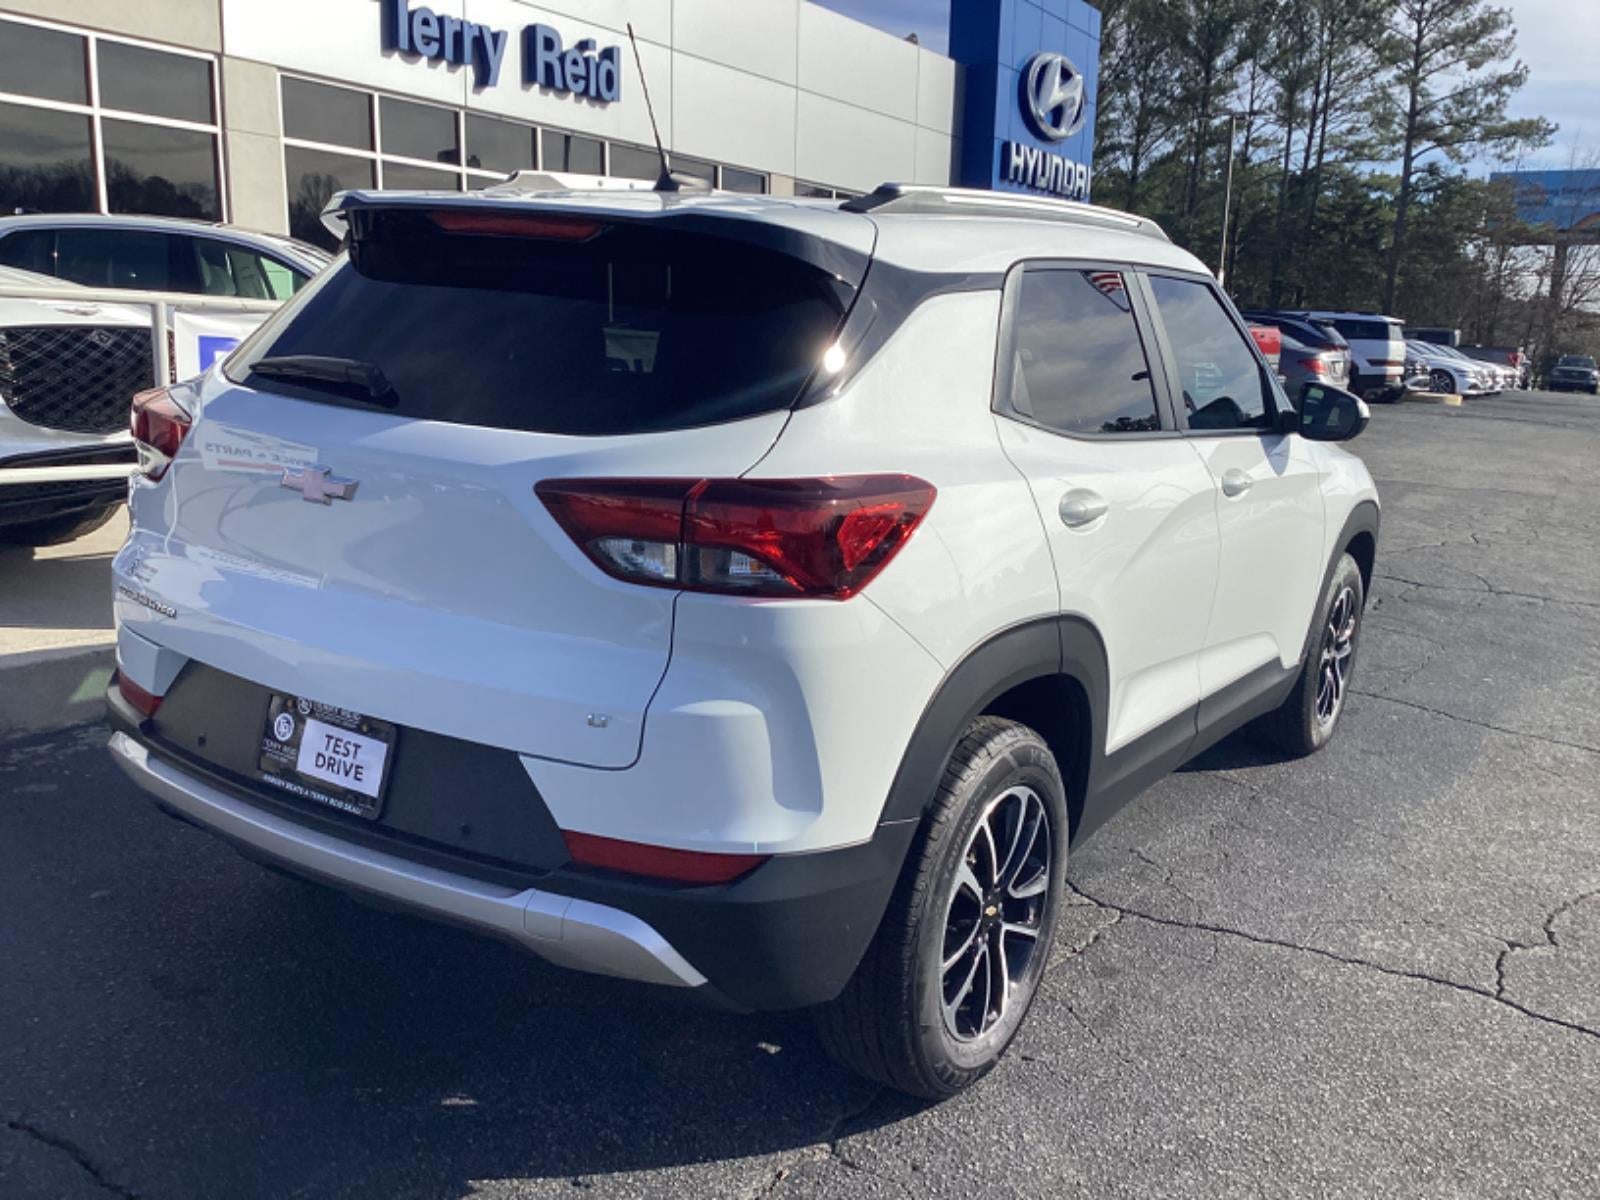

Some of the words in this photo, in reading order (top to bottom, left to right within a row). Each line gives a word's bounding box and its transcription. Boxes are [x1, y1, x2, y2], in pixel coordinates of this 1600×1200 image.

[381, 0, 507, 88] Terry
[521, 23, 620, 103] Reid
[1001, 140, 1092, 201] HYUNDAI
[314, 752, 364, 783] DRIVE
[324, 733, 362, 761] TEST
